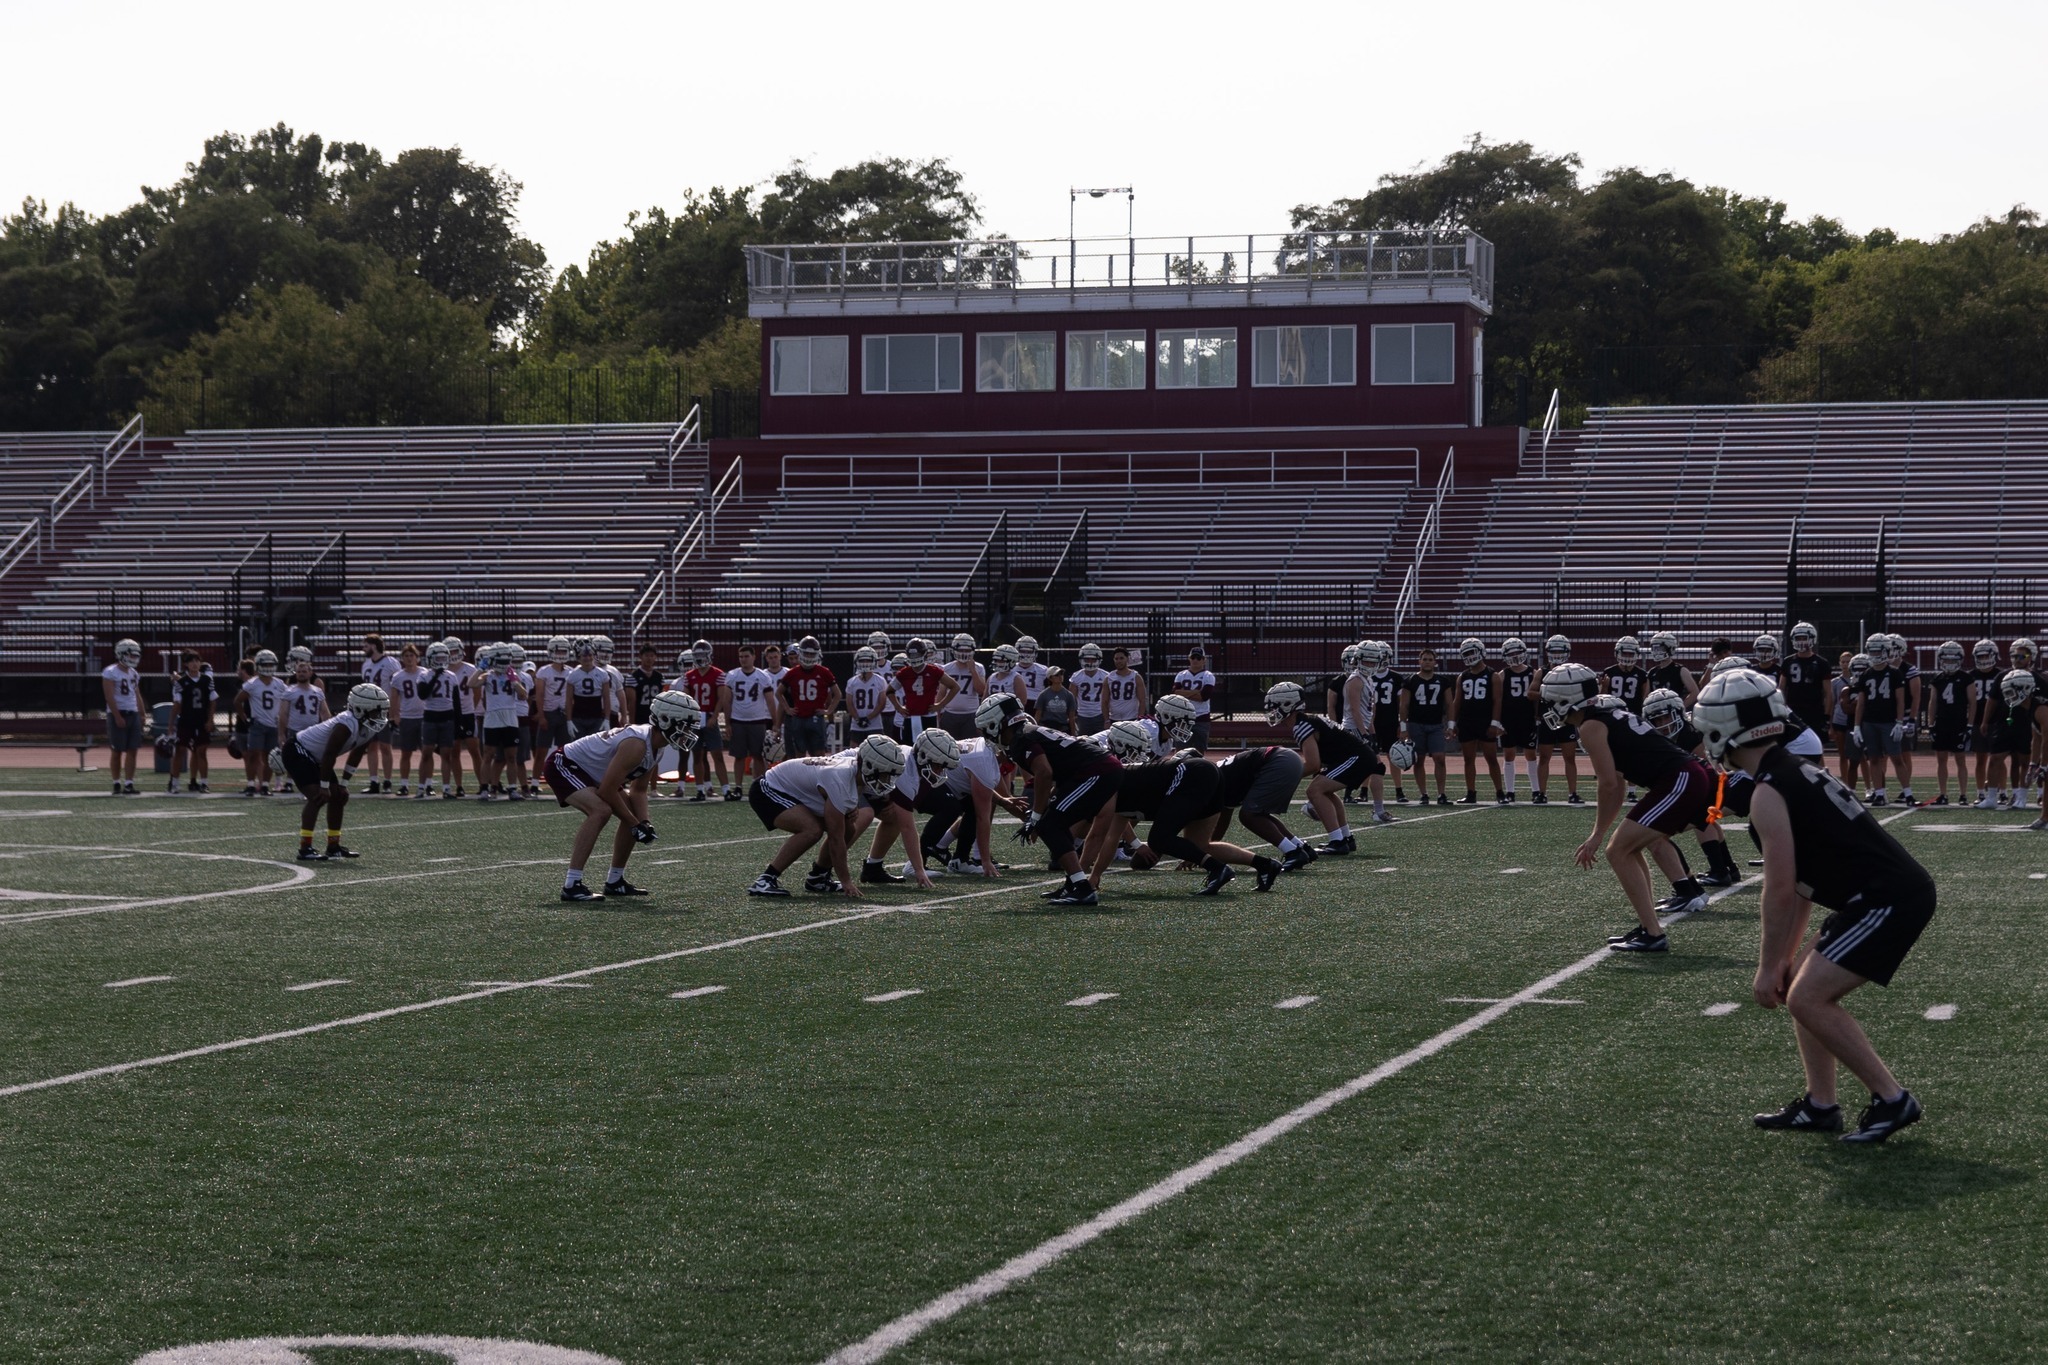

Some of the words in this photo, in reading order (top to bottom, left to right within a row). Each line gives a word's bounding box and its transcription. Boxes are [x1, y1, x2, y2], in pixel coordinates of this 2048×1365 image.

[403, 680, 414, 698] 8
[432, 680, 450, 698] 21
[492, 679, 513, 696] 14
[554, 677, 566, 695] 7
[582, 678, 594, 695] 9
[693, 683, 711, 705] 12
[736, 681, 759, 701] 54
[798, 679, 817, 701] 16
[912, 675, 924, 695] 4
[1080, 683, 1103, 702] 27
[1111, 681, 1134, 700] 88
[1415, 684, 1441, 705] 47
[1462, 678, 1487, 700] 96
[1611, 676, 1638, 698] 93
[1865, 678, 1890, 700] 34
[1941, 682, 1953, 704] 4
[192, 688, 202, 709] 2
[262, 691, 274, 709] 6
[295, 695, 318, 714] 43
[856, 689, 874, 709] 81
